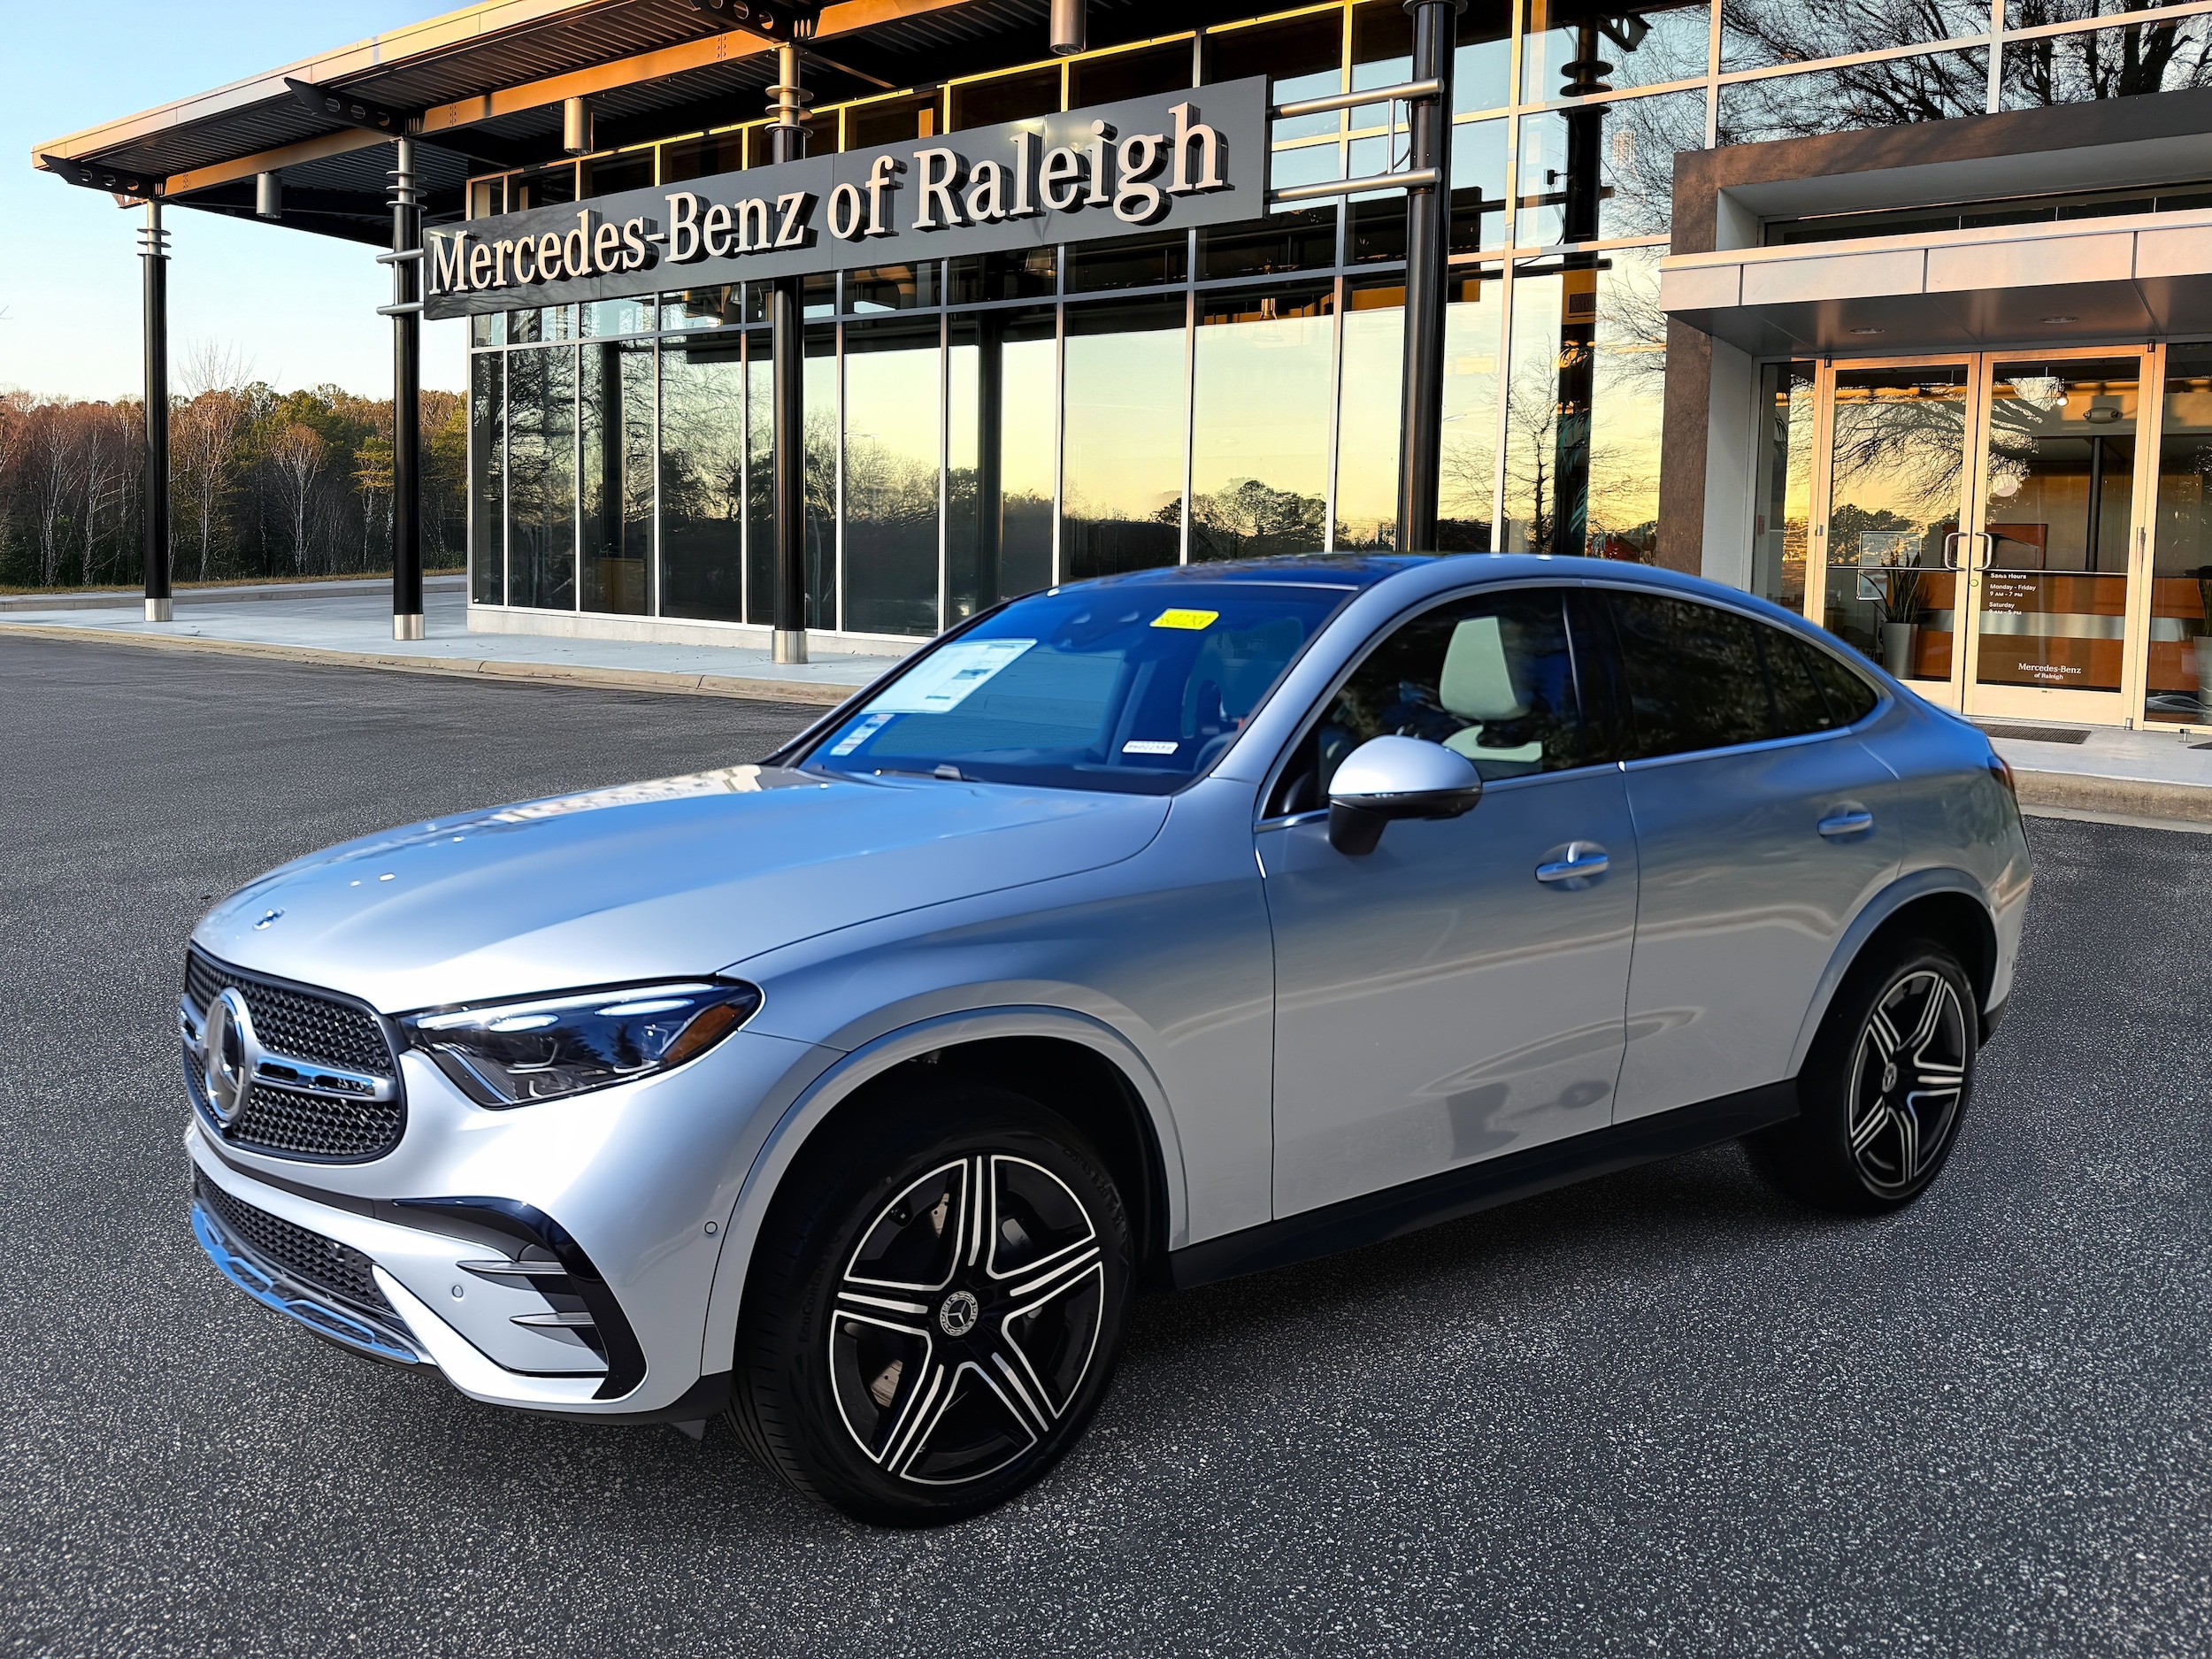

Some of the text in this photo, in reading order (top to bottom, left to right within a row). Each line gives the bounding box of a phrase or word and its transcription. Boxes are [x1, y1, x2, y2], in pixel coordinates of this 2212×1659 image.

[428, 101, 1228, 296] Mercedes-Benz of Raleigh
[2018, 663, 2081, 674] Mercedes-Benz
